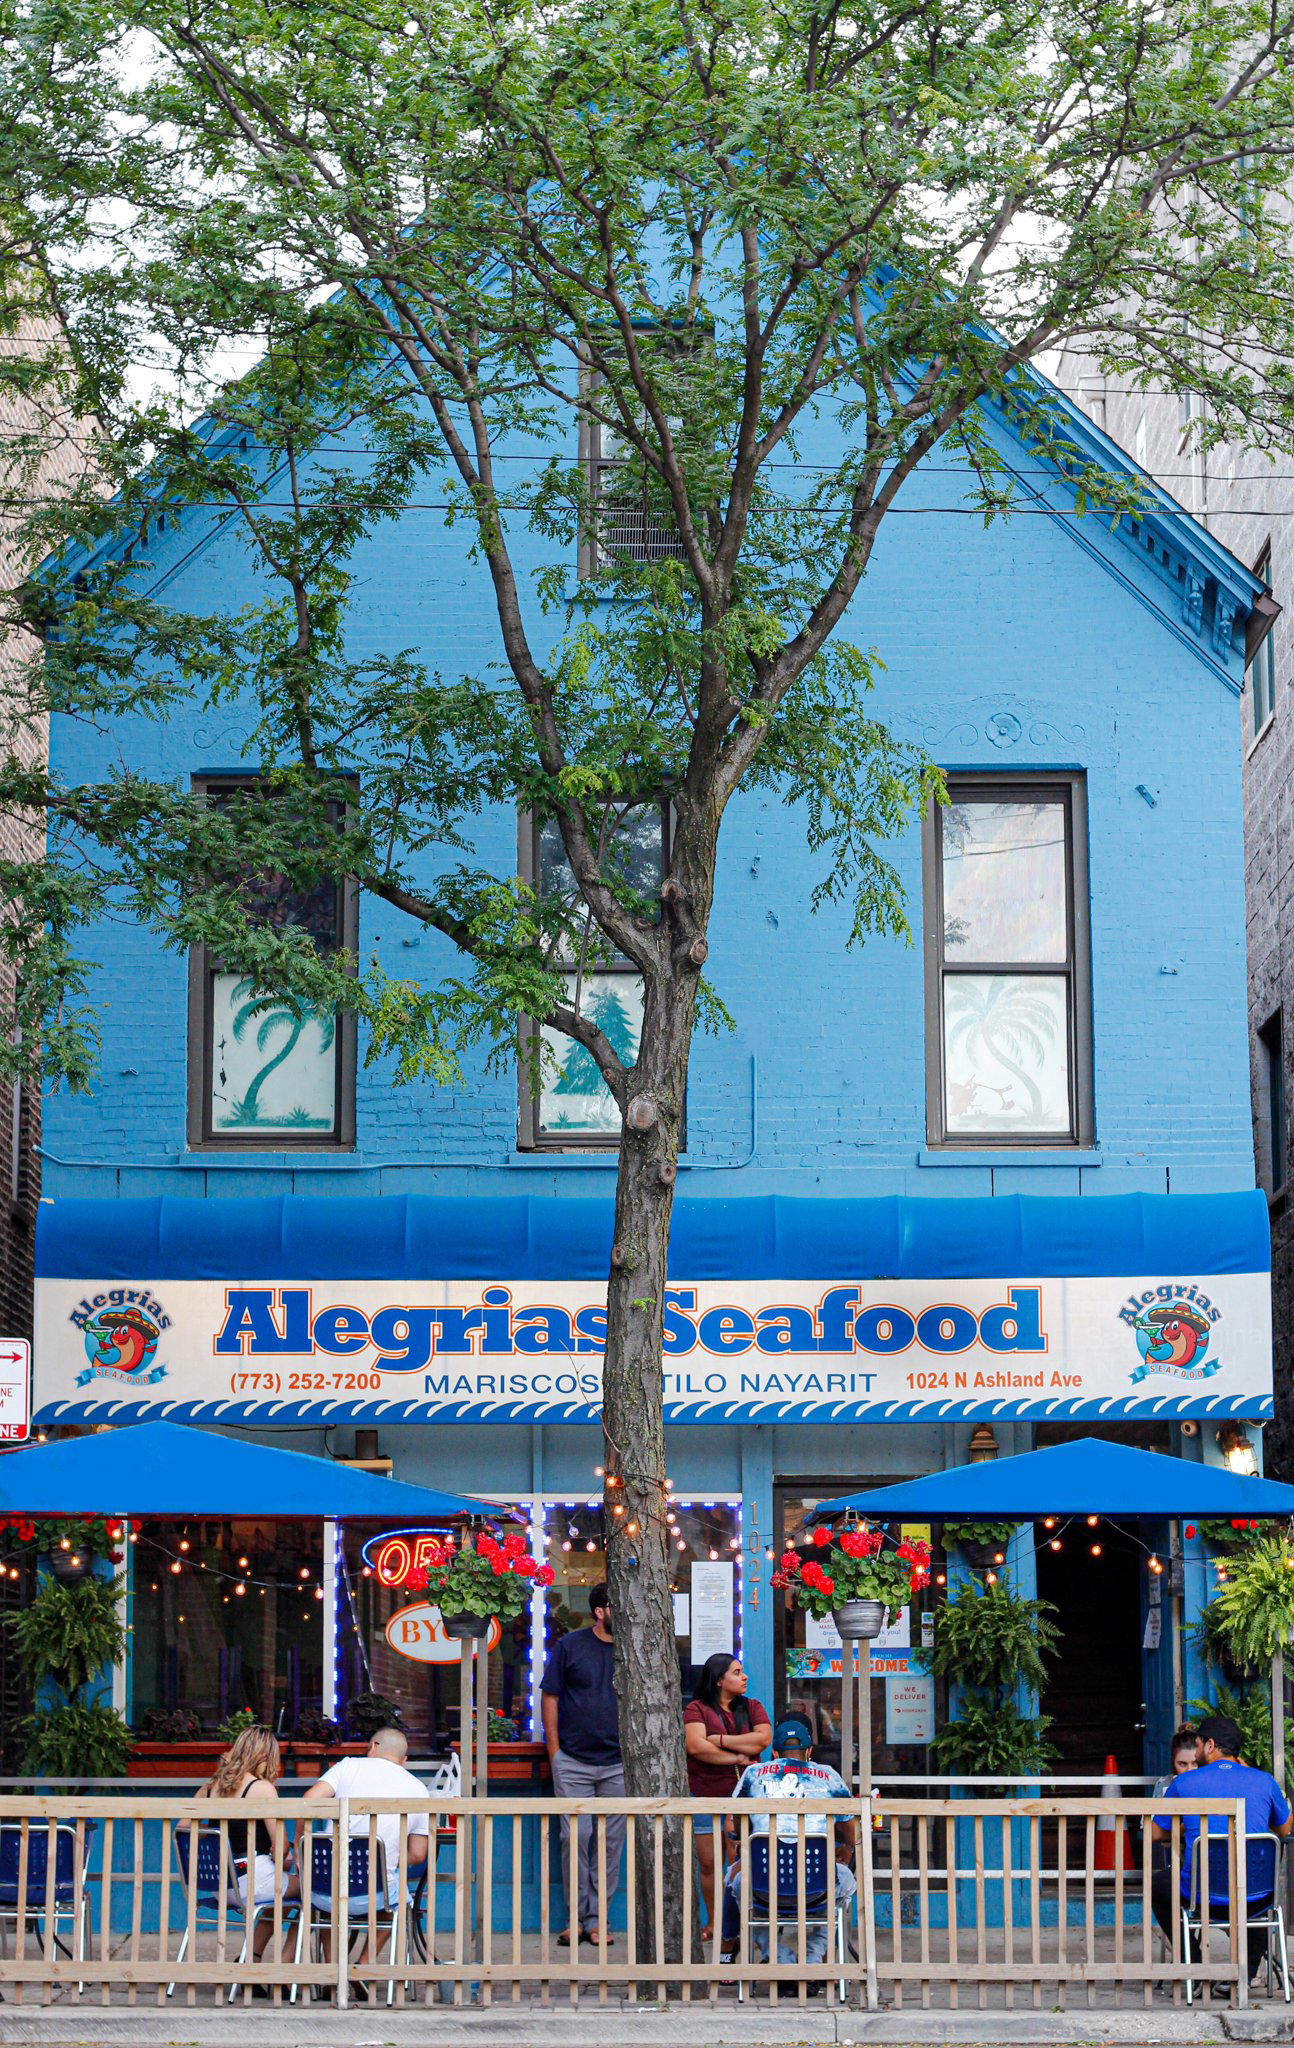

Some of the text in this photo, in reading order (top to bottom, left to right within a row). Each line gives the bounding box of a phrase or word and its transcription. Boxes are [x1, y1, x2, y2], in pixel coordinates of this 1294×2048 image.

[69, 1288, 172, 1330] Alegrias
[1118, 1284, 1222, 1327] Alegrias
[213, 1284, 1048, 1375] Alegrias Seafood
[96, 1369, 150, 1384] SEAFOOD
[906, 1371, 1083, 1389] 1024 N Ashland Ave
[1150, 1365, 1203, 1379] SEAFOOD
[230, 1373, 381, 1394] (773) 252-7200
[424, 1373, 878, 1394] MARISCOS TILO NAYARIT
[748, 1501, 760, 1612] 1024
